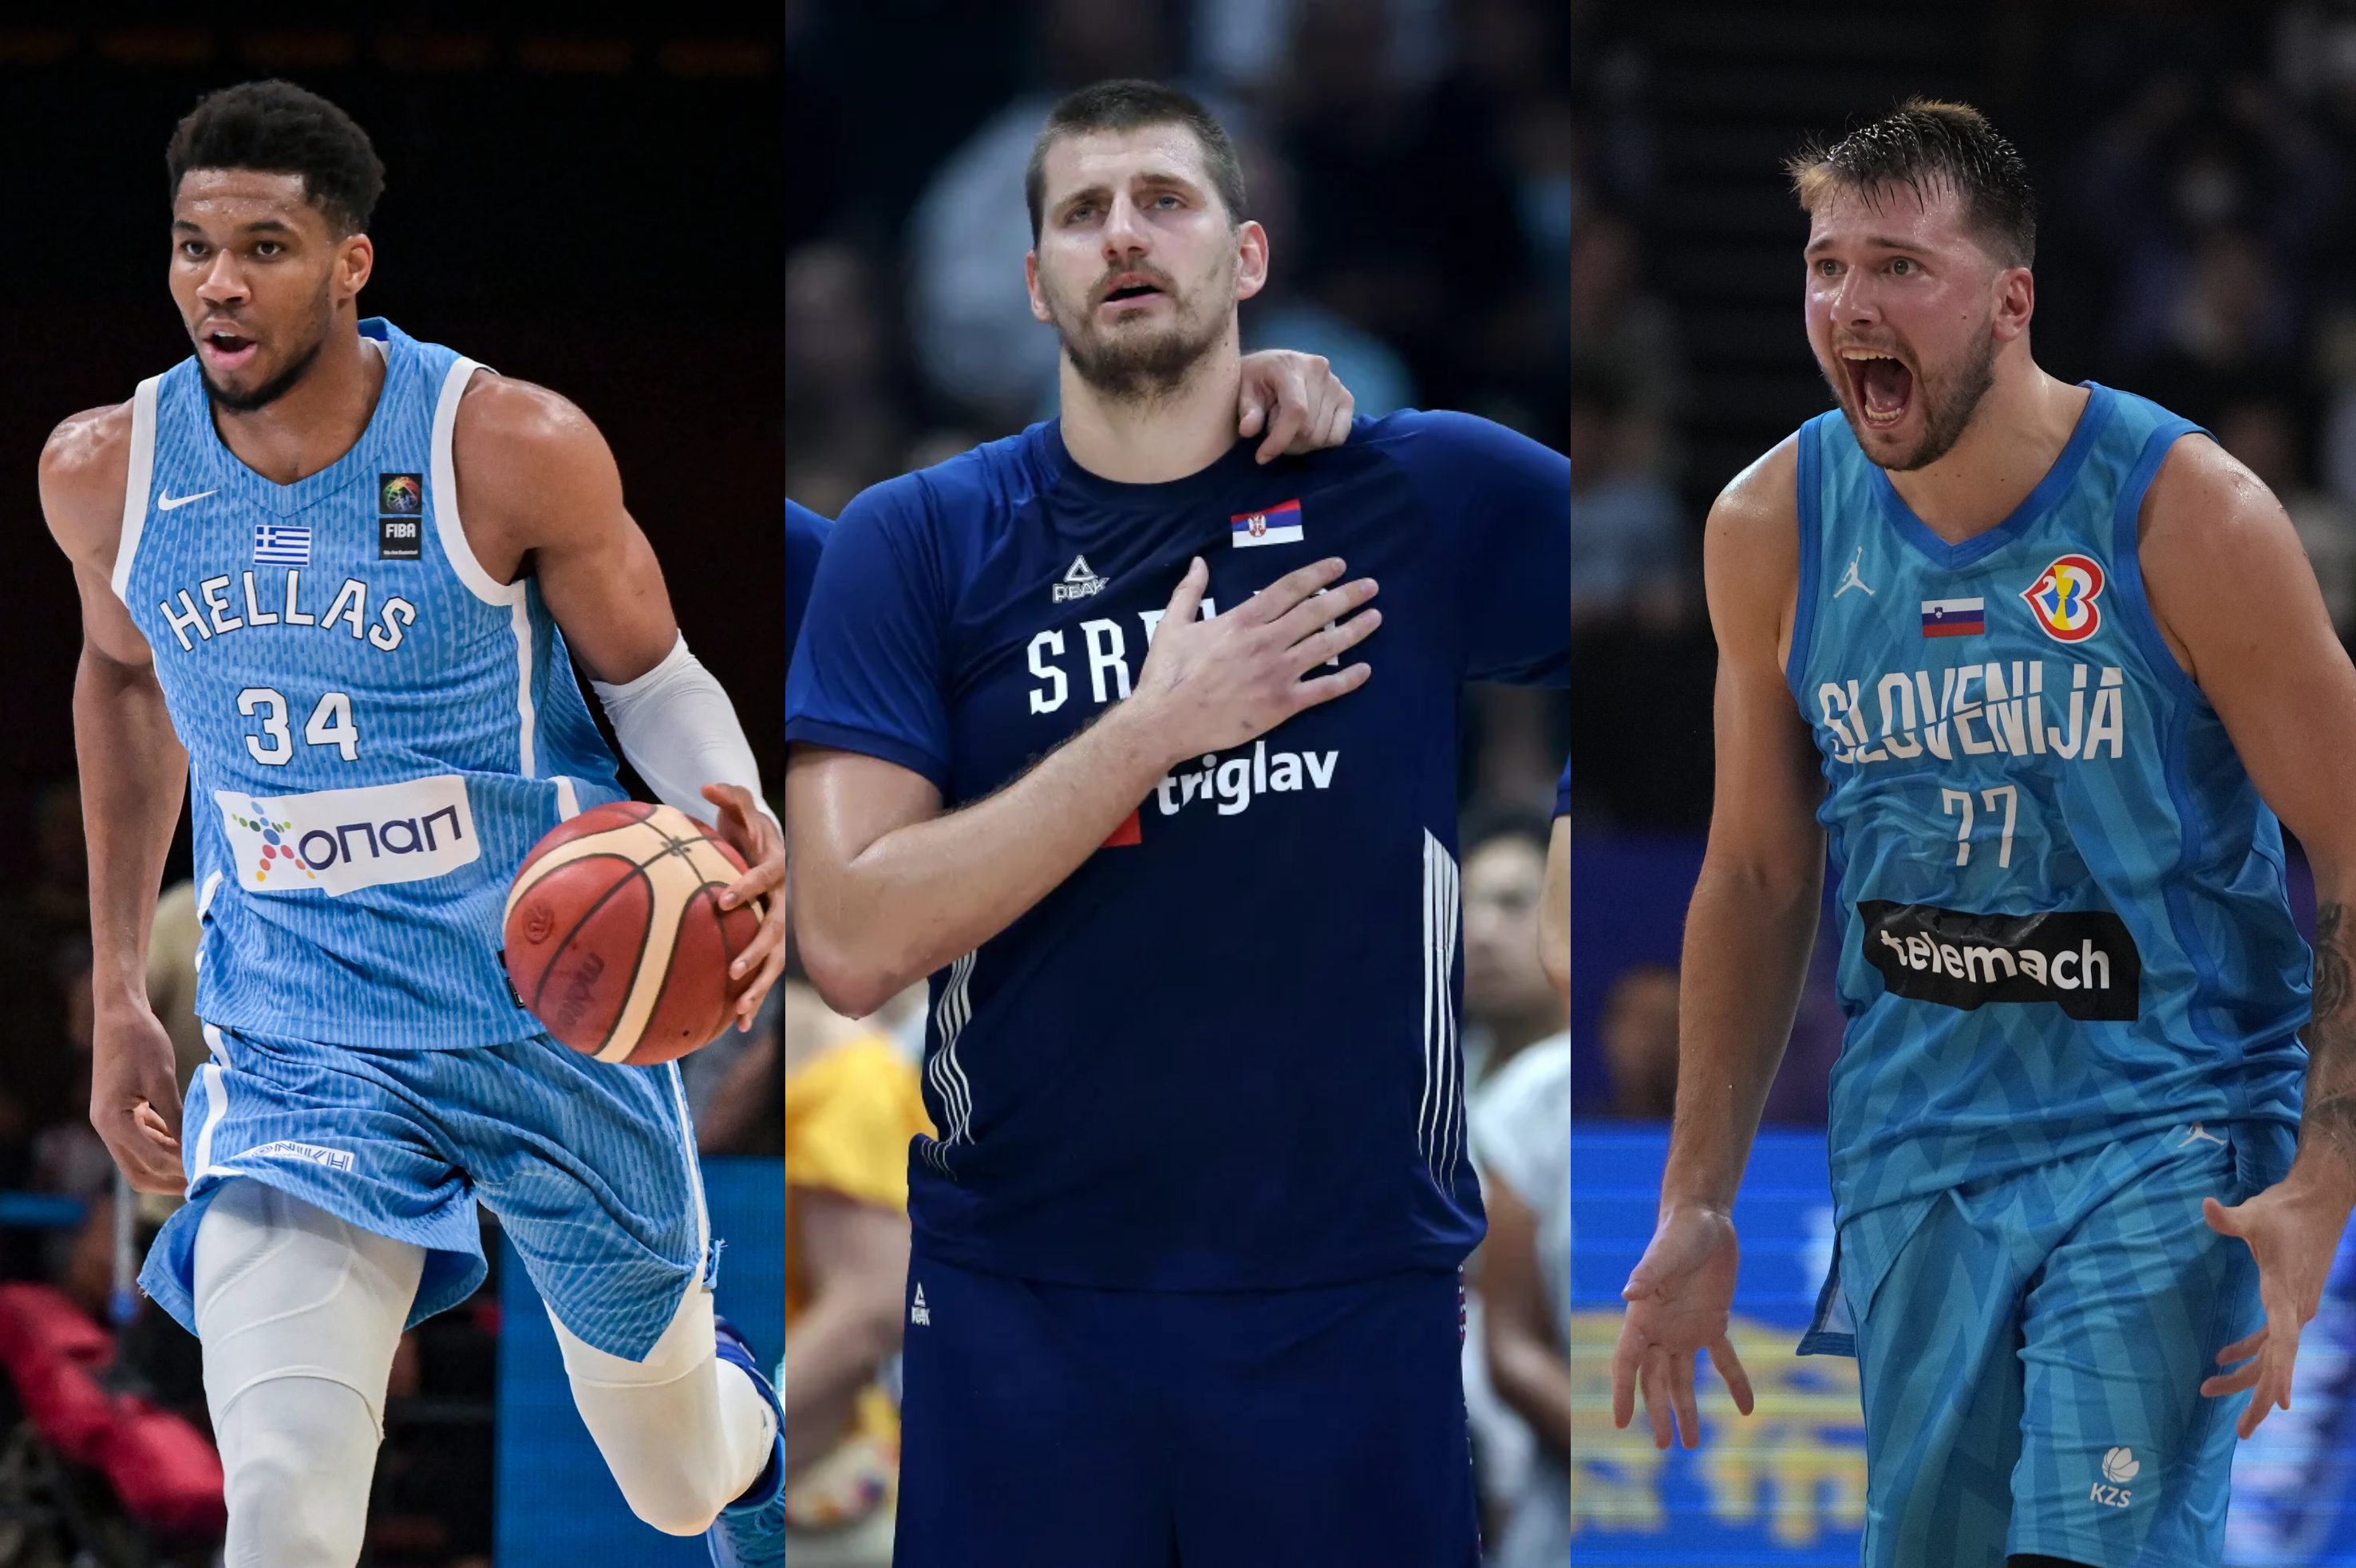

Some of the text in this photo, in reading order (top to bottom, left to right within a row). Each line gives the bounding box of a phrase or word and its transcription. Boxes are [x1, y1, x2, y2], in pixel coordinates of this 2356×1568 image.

[385, 523, 417, 539] FIBA
[160, 569, 417, 653] HELLAS
[1052, 577, 1110, 603] PEAK
[236, 687, 360, 766] 34
[1818, 660, 2124, 764] SLOVENIJA
[1157, 740, 1339, 816] triglav
[1941, 784, 2018, 869] 77
[1880, 930, 2110, 990] telemach
[2089, 1482, 2133, 1508] KZS
